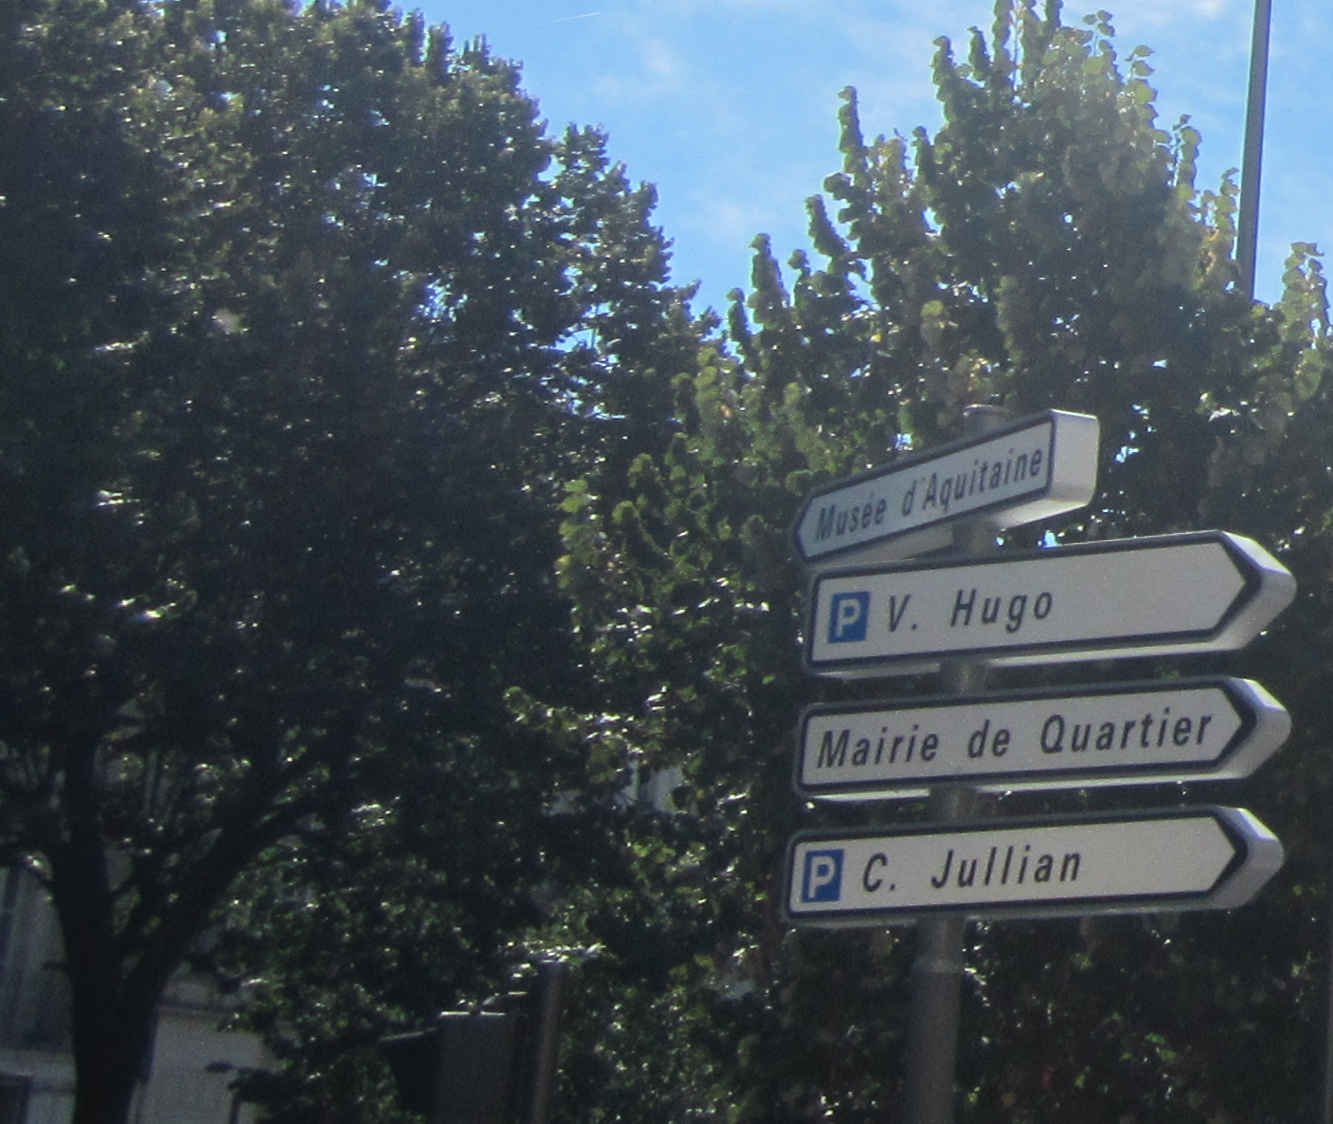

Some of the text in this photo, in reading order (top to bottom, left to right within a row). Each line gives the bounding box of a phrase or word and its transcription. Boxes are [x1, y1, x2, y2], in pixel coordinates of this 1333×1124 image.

[814, 445, 1044, 541] Musée d'Aquitaine
[888, 596, 918, 631] V.
[950, 588, 1054, 635] Hugo
[817, 709, 1213, 770] Mairie de Quartier
[862, 855, 896, 894] C.
[931, 846, 1082, 890] Jullian
